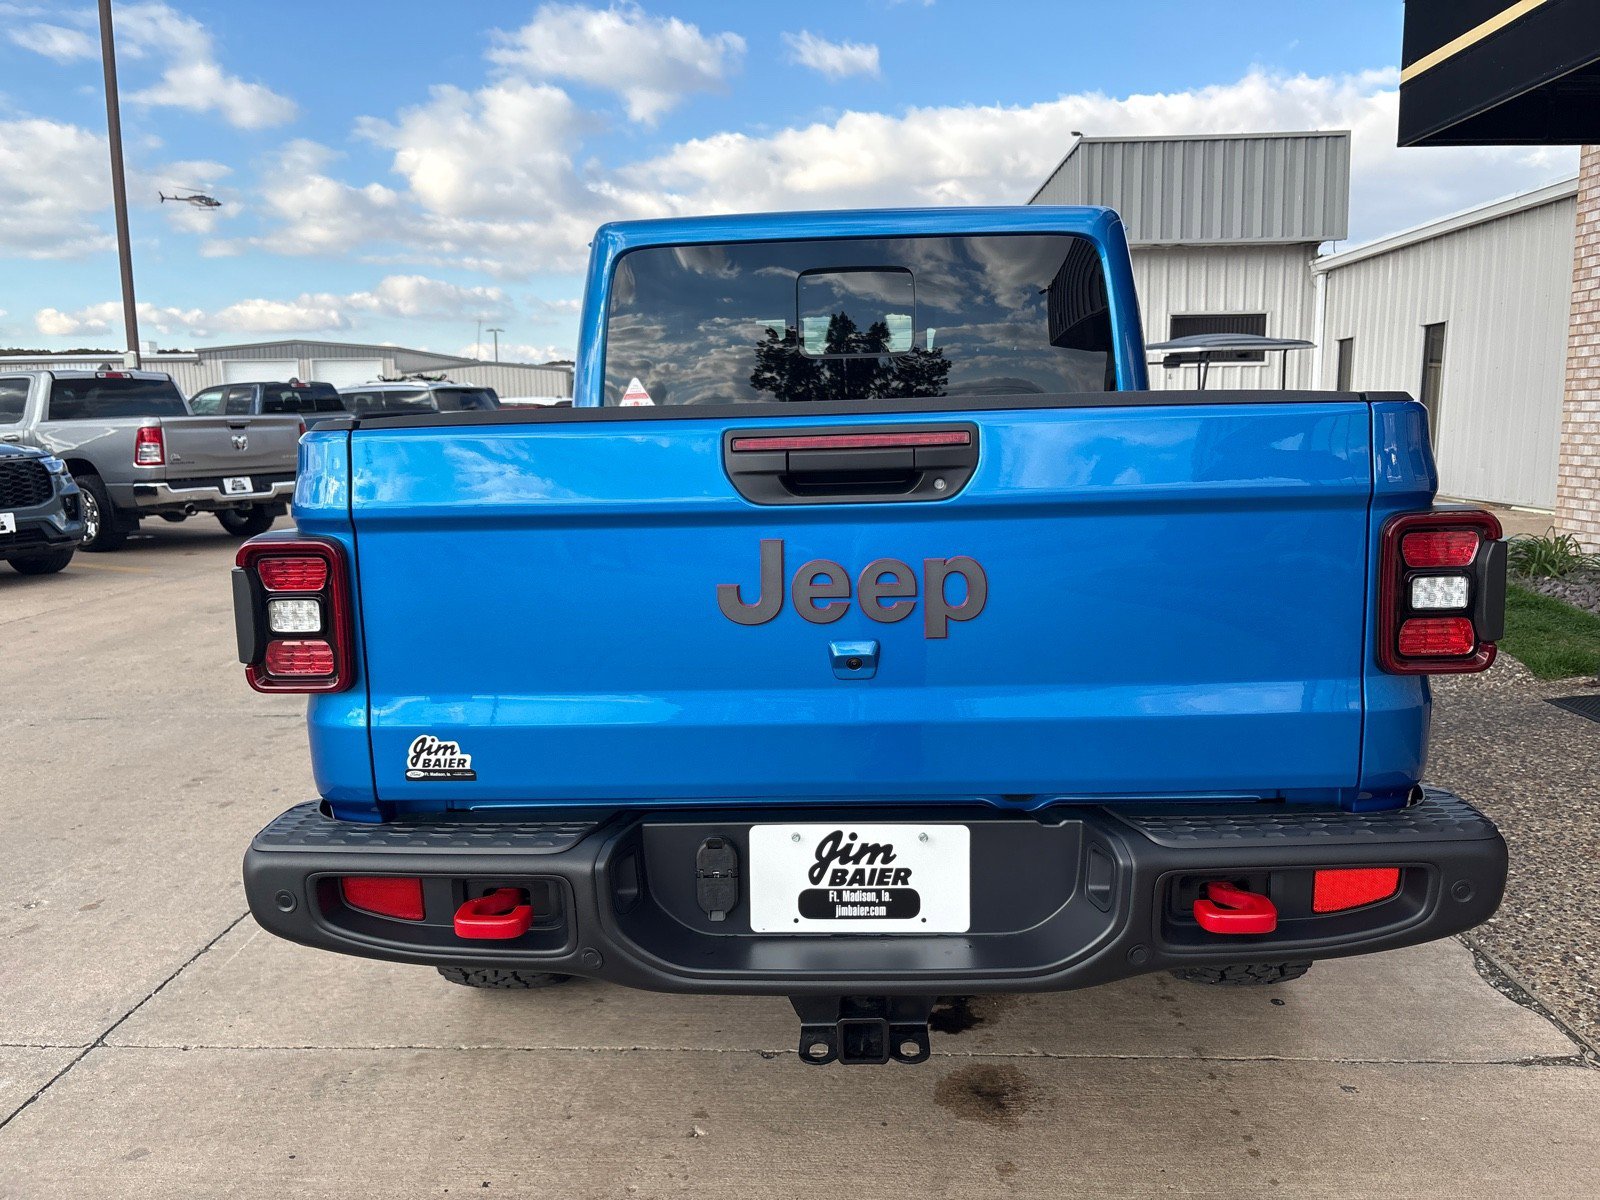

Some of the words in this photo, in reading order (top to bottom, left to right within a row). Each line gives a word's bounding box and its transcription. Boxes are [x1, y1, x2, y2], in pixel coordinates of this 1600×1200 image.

[717, 539, 988, 639] Jeep
[410, 737, 457, 767] Jim
[422, 758, 467, 768] BAIER
[808, 830, 897, 886] Jim
[828, 868, 912, 886] BAIER
[829, 890, 840, 902] Ft.
[842, 890, 879, 903] Madison,
[882, 890, 892, 902] Ia.
[835, 904, 886, 918] jimbaier.com
